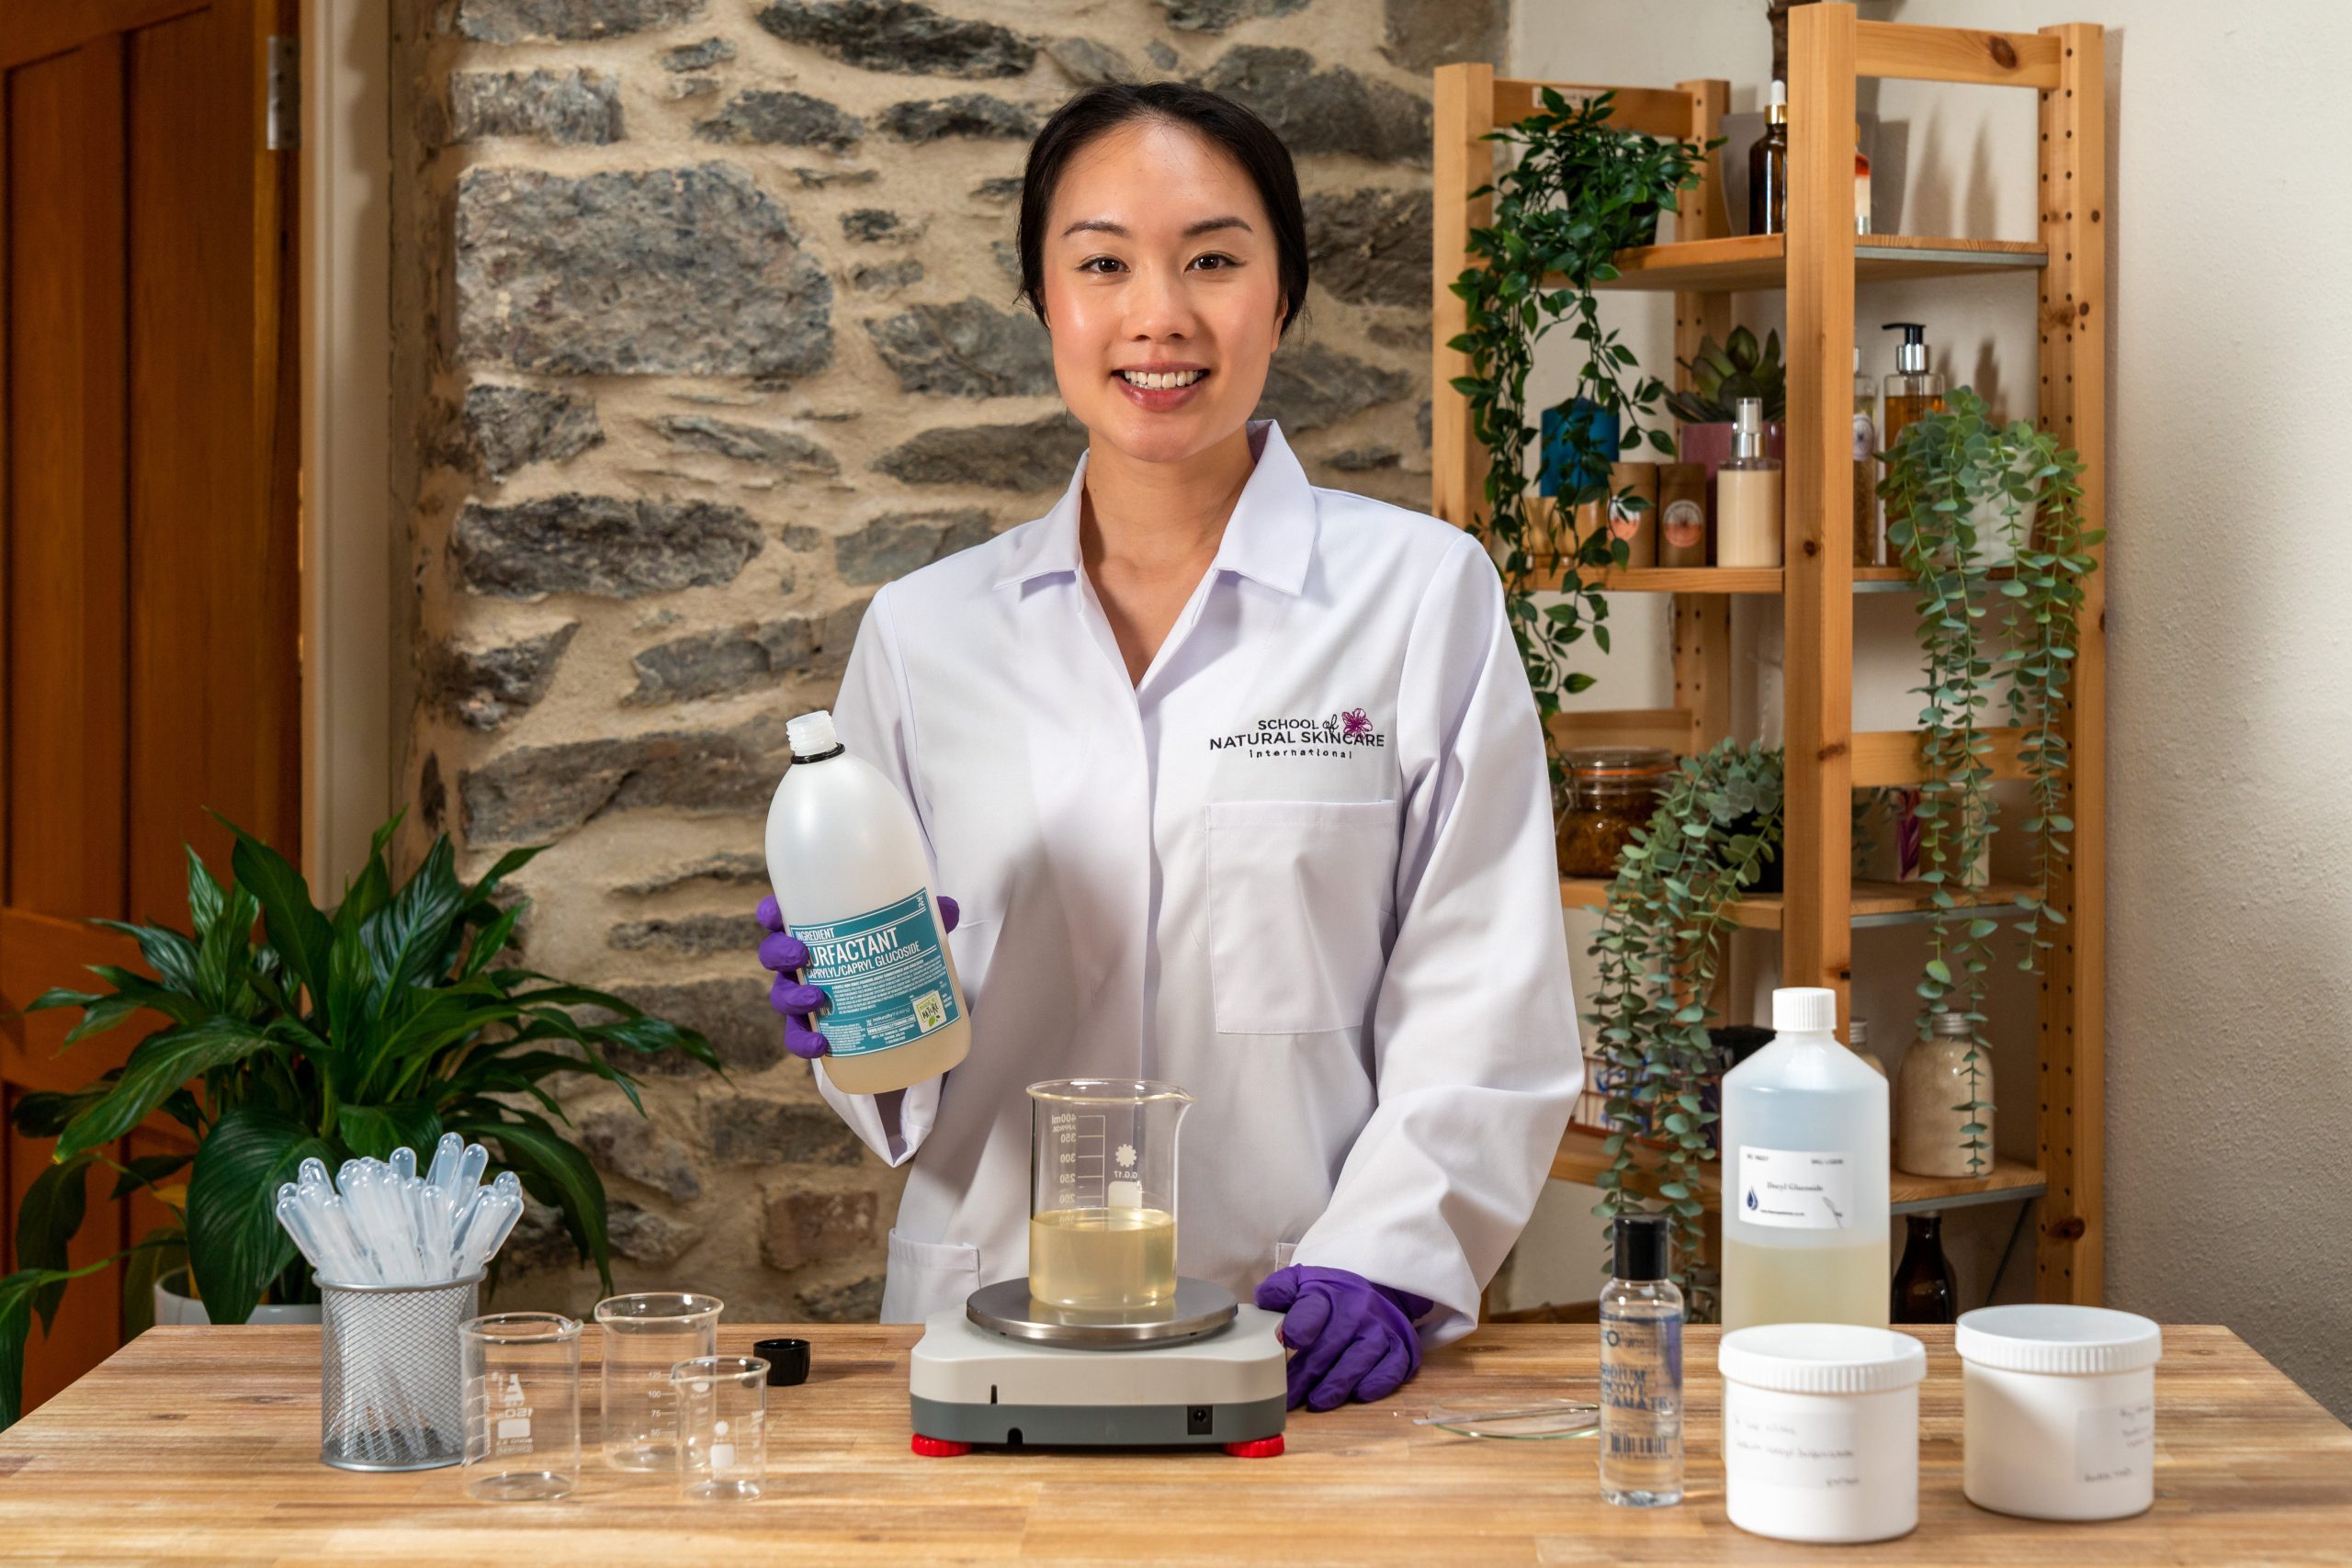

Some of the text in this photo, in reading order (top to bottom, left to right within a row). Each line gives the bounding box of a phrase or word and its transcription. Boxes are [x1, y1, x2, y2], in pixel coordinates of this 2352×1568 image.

[1258, 714, 1340, 733] SCHOOL of
[1209, 730, 1385, 750] NATURAL SKINCARE
[1250, 749, 1352, 760] International
[796, 928, 835, 942] INGREDIENT
[806, 927, 899, 967] URFACTANT
[875, 941, 922, 967] GLUCOSIDE
[648, 1390, 662, 1398] 100
[651, 1409, 662, 1418] 75
